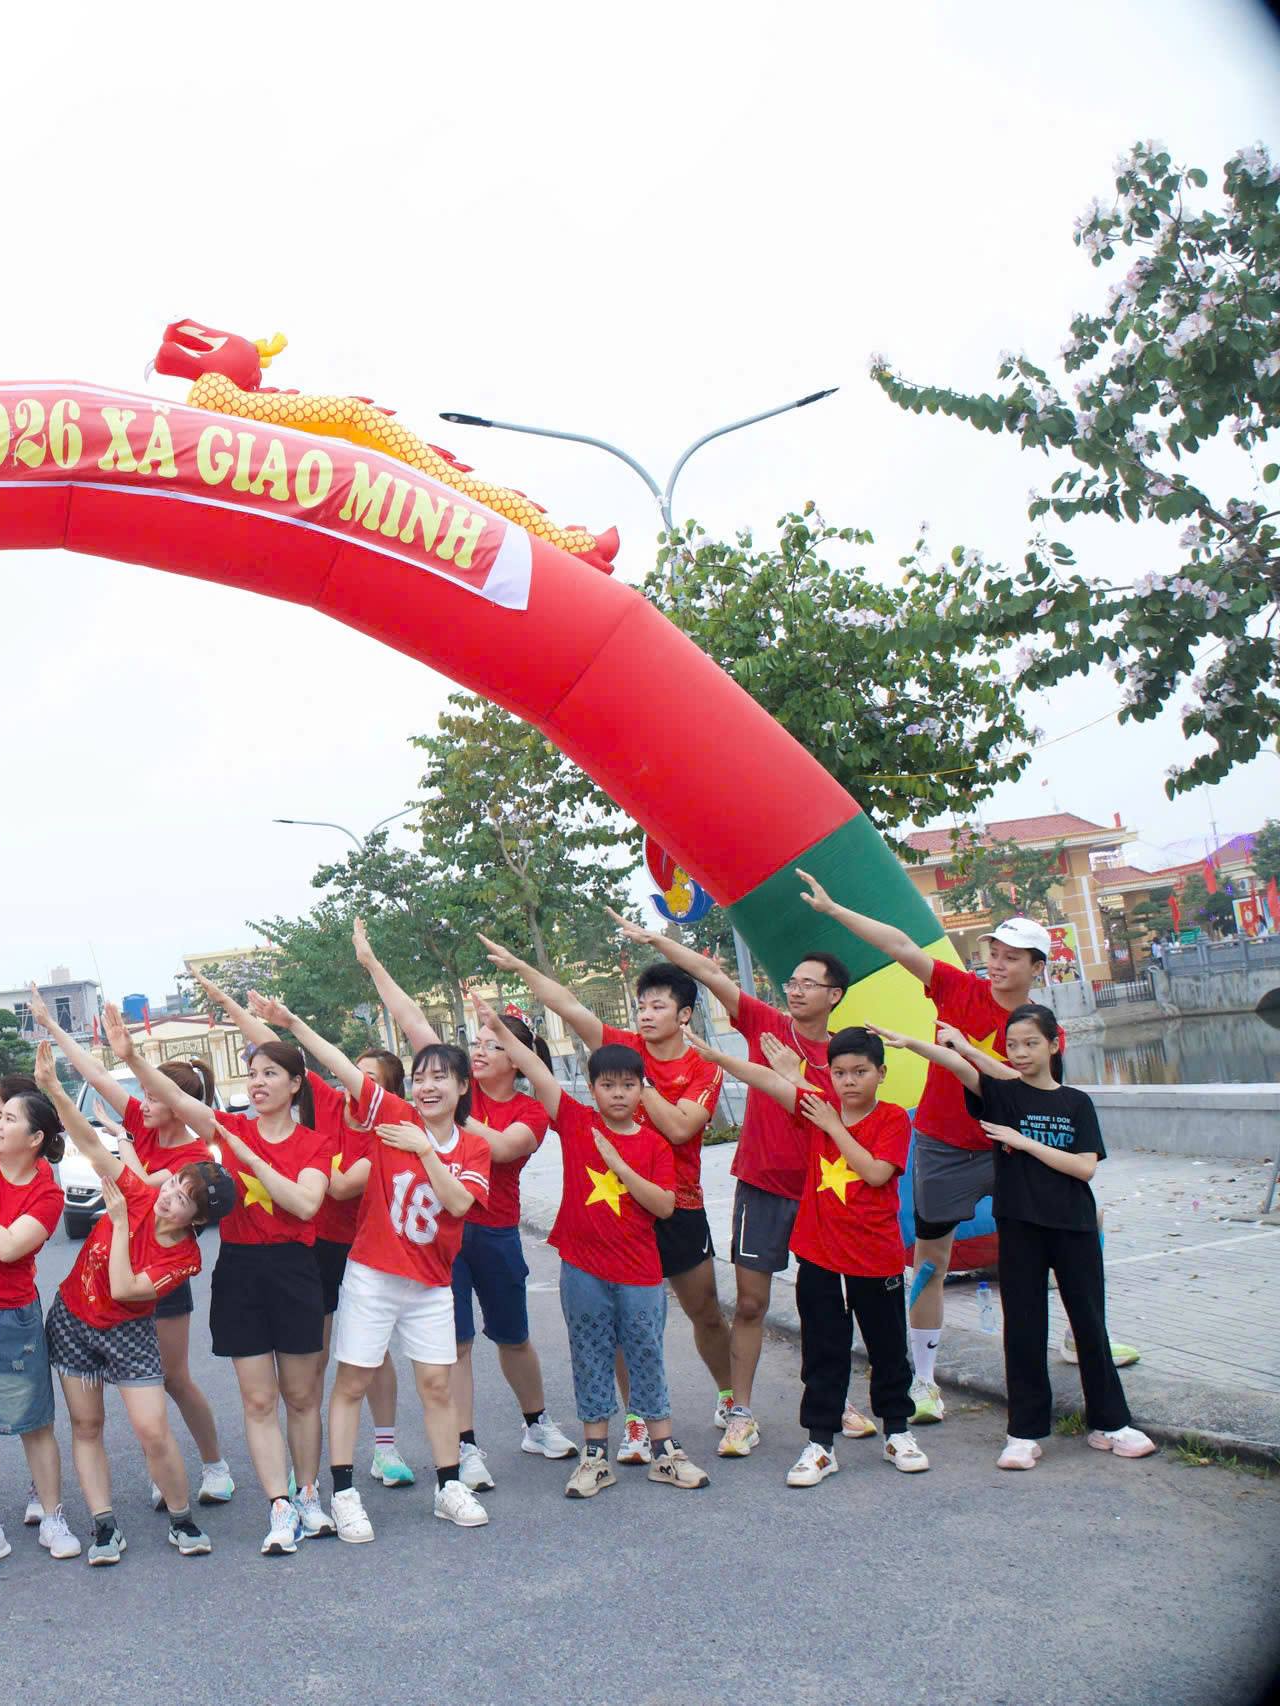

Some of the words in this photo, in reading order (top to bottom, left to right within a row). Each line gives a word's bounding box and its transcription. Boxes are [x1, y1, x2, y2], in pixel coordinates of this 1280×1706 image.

[98, 402, 179, 479] XÃ
[196, 424, 334, 510] GIAO
[338, 459, 488, 569] MINH
[389, 1169, 445, 1246] 18
